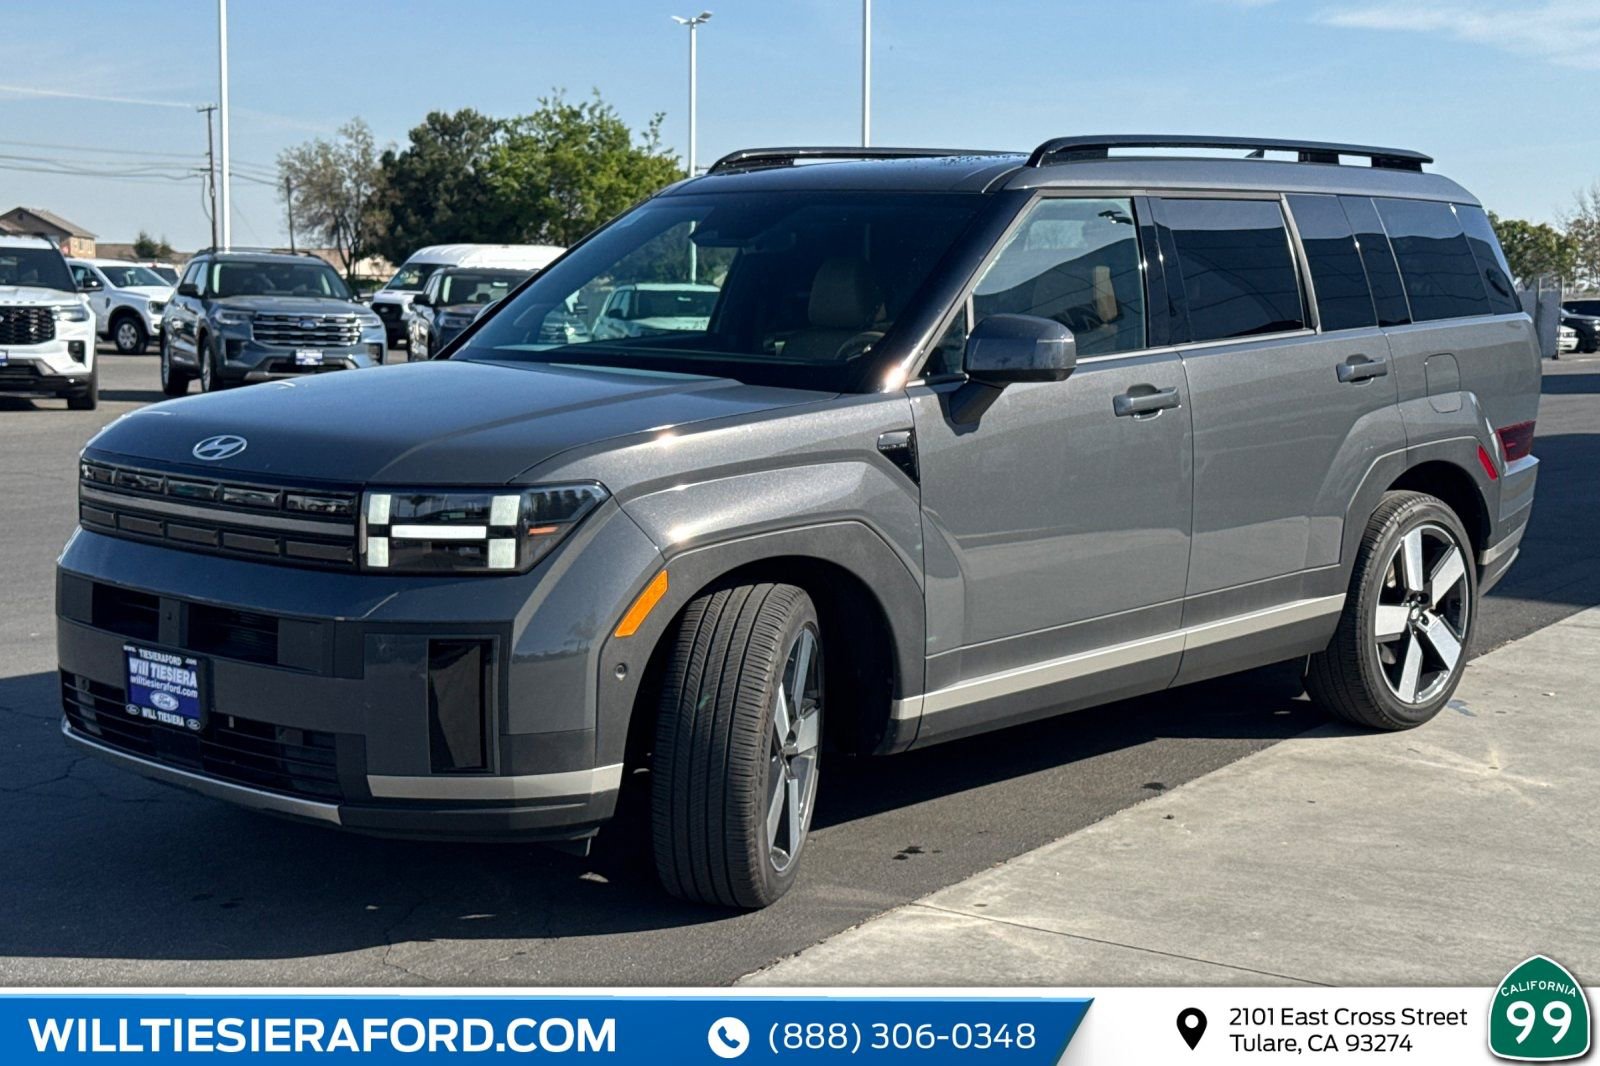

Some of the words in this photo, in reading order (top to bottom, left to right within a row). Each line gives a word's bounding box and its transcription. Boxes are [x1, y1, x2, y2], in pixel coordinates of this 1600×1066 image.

[150, 661, 198, 689] TIESIERA
[130, 676, 198, 698] willtiesieraford.com
[141, 707, 157, 720] WILL
[157, 711, 185, 727] TIESIERA
